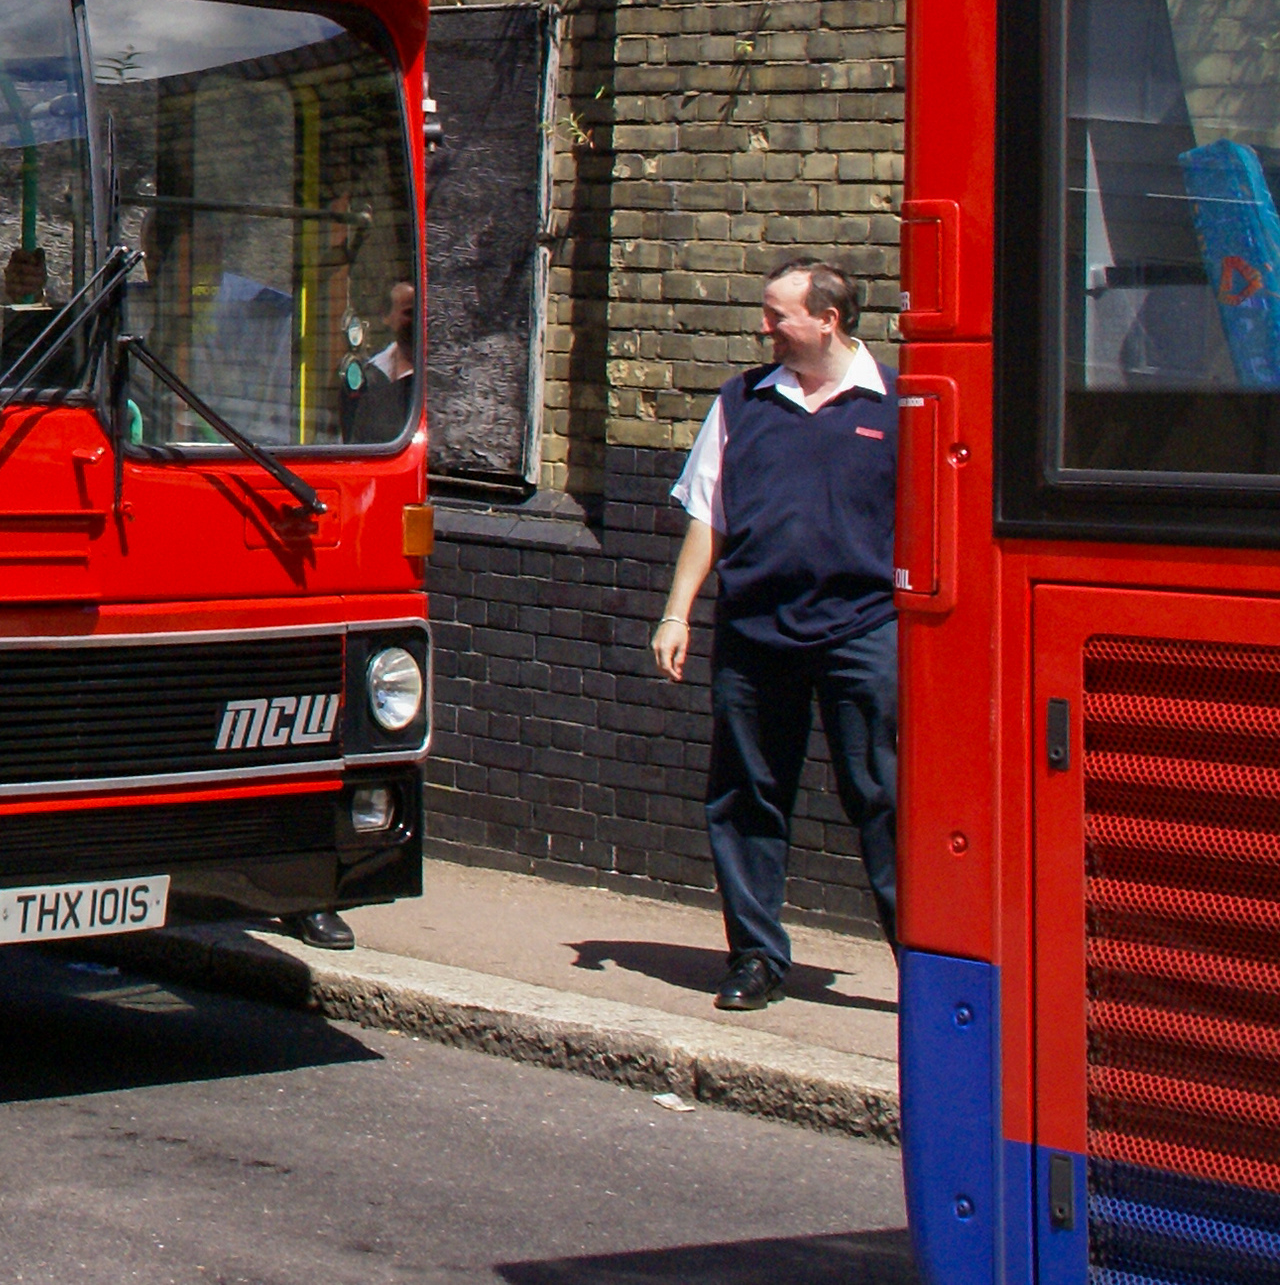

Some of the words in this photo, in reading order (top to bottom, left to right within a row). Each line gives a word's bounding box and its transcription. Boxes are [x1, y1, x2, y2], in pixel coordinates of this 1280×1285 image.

[215, 694, 340, 750] MCW
[17, 890, 83, 933] THX
[89, 885, 150, 928] 101S
